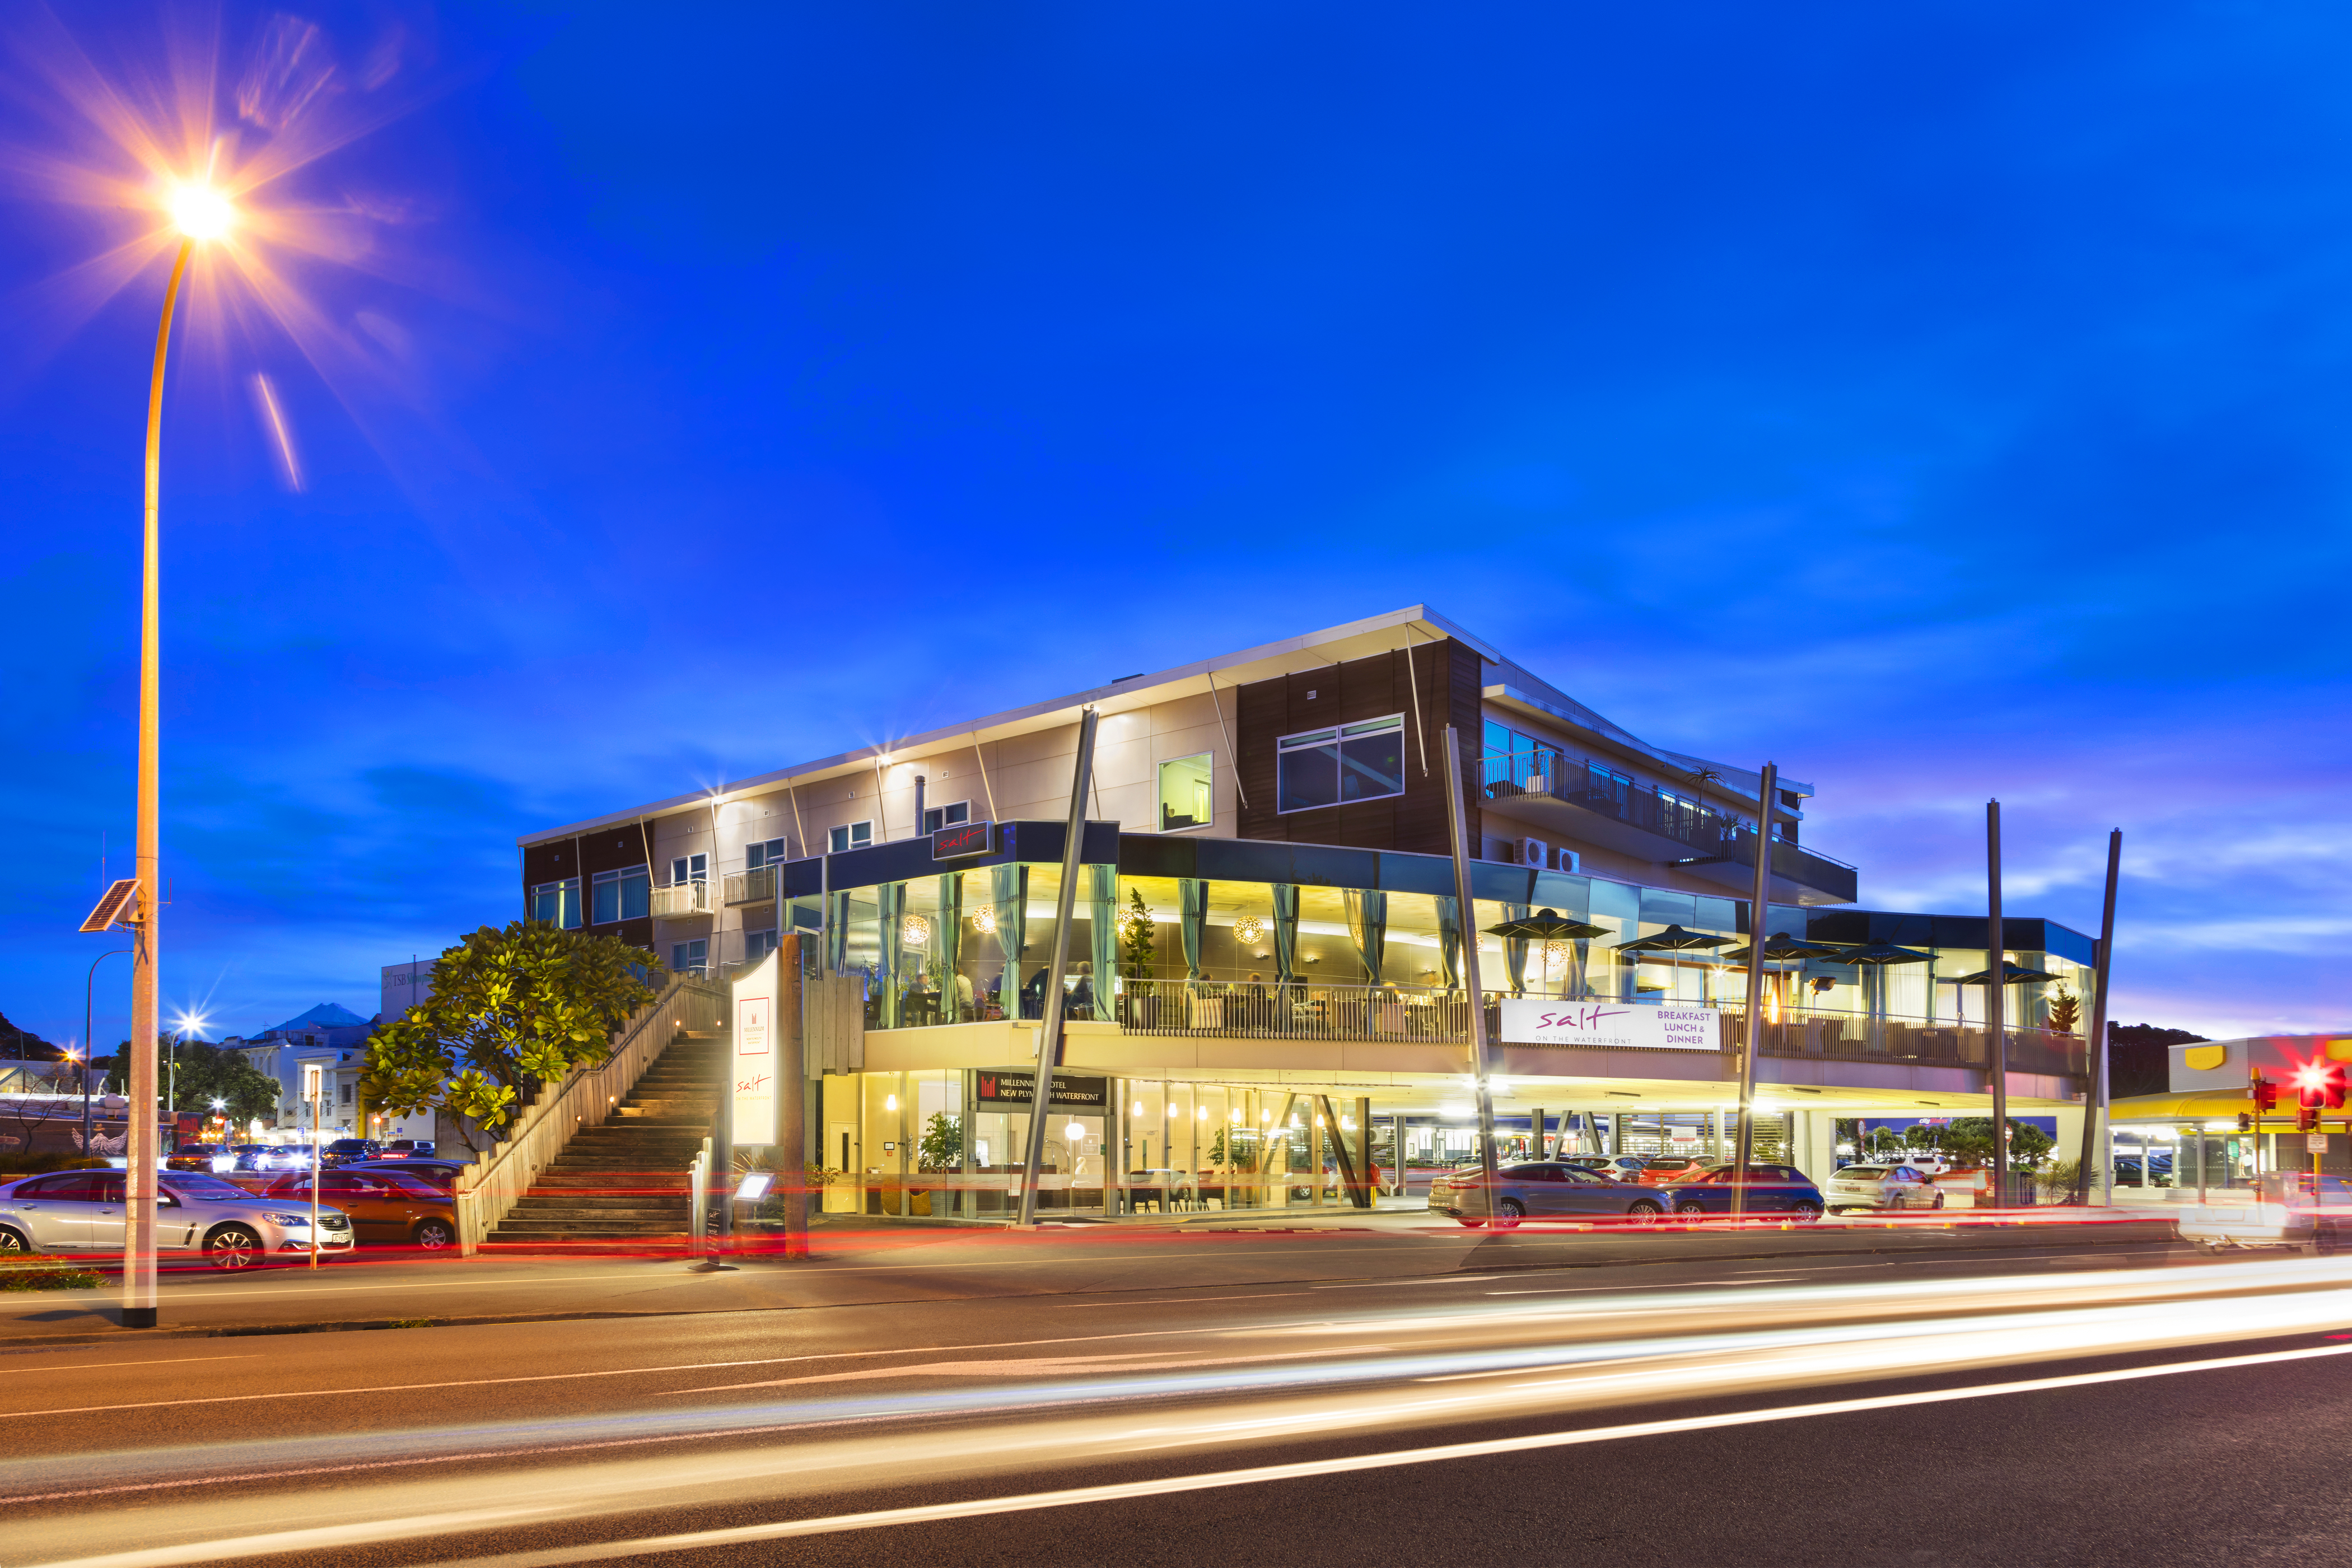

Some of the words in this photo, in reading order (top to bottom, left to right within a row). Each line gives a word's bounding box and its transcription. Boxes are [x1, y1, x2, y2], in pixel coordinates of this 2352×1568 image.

[937, 829, 985, 851] salt
[393, 973, 407, 986] TSB
[1536, 1005, 1631, 1030] salt
[1658, 1011, 1711, 1021] BREAKFAST
[1664, 1023, 1696, 1032] LUNCH
[1667, 1035, 1703, 1044] DINNER
[736, 1074, 772, 1093] salt
[1056, 1092, 1099, 1100] WATERFRONT
